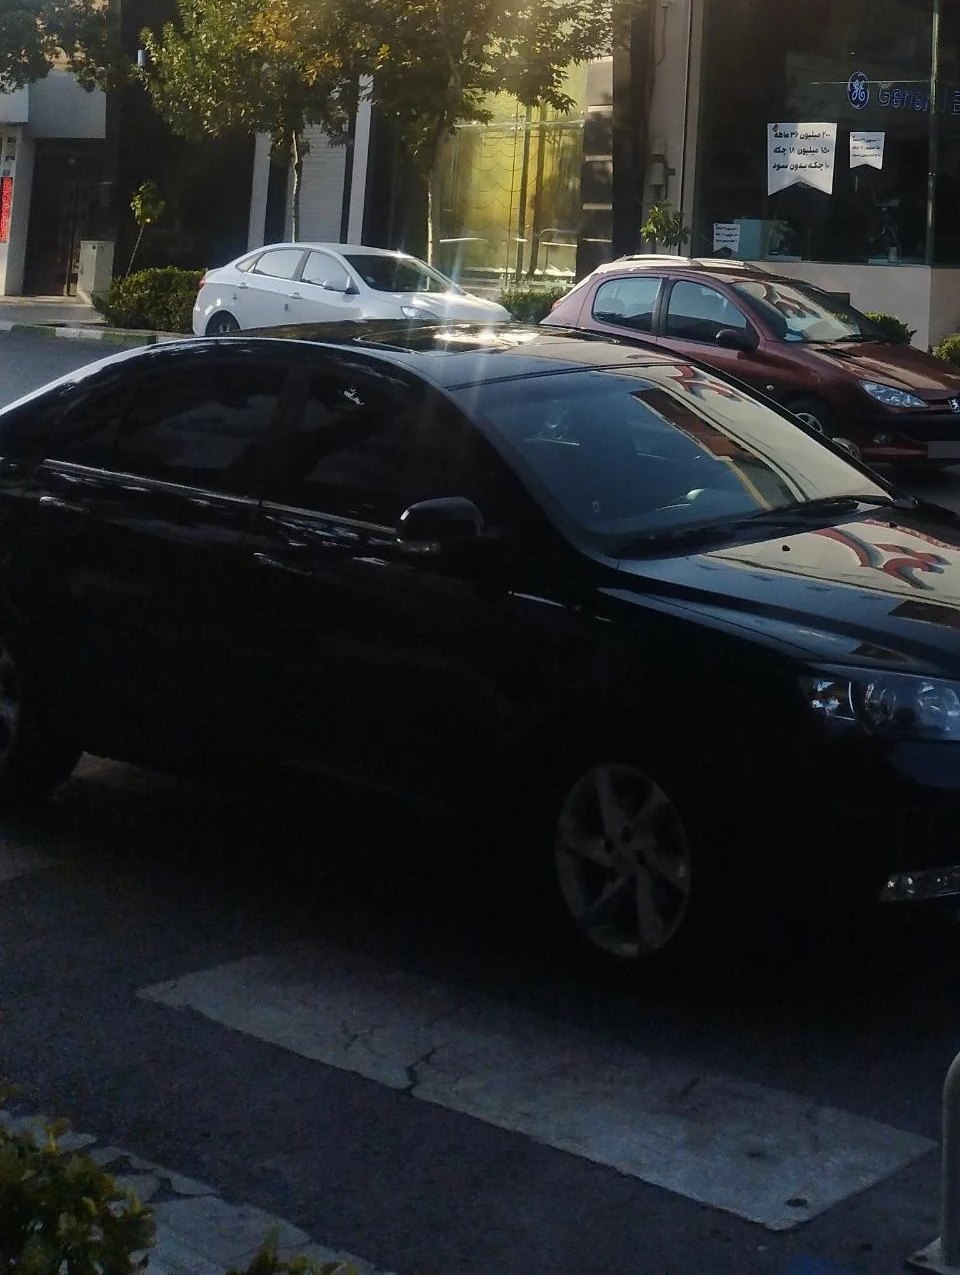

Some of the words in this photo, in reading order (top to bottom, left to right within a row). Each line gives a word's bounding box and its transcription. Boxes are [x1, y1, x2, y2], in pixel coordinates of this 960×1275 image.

[878, 83, 948, 113] Generl
[799, 130, 821, 141] میلیون
[797, 146, 819, 156] میلیون
[772, 162, 789, 171] سود
[789, 163, 808, 172] بدون
